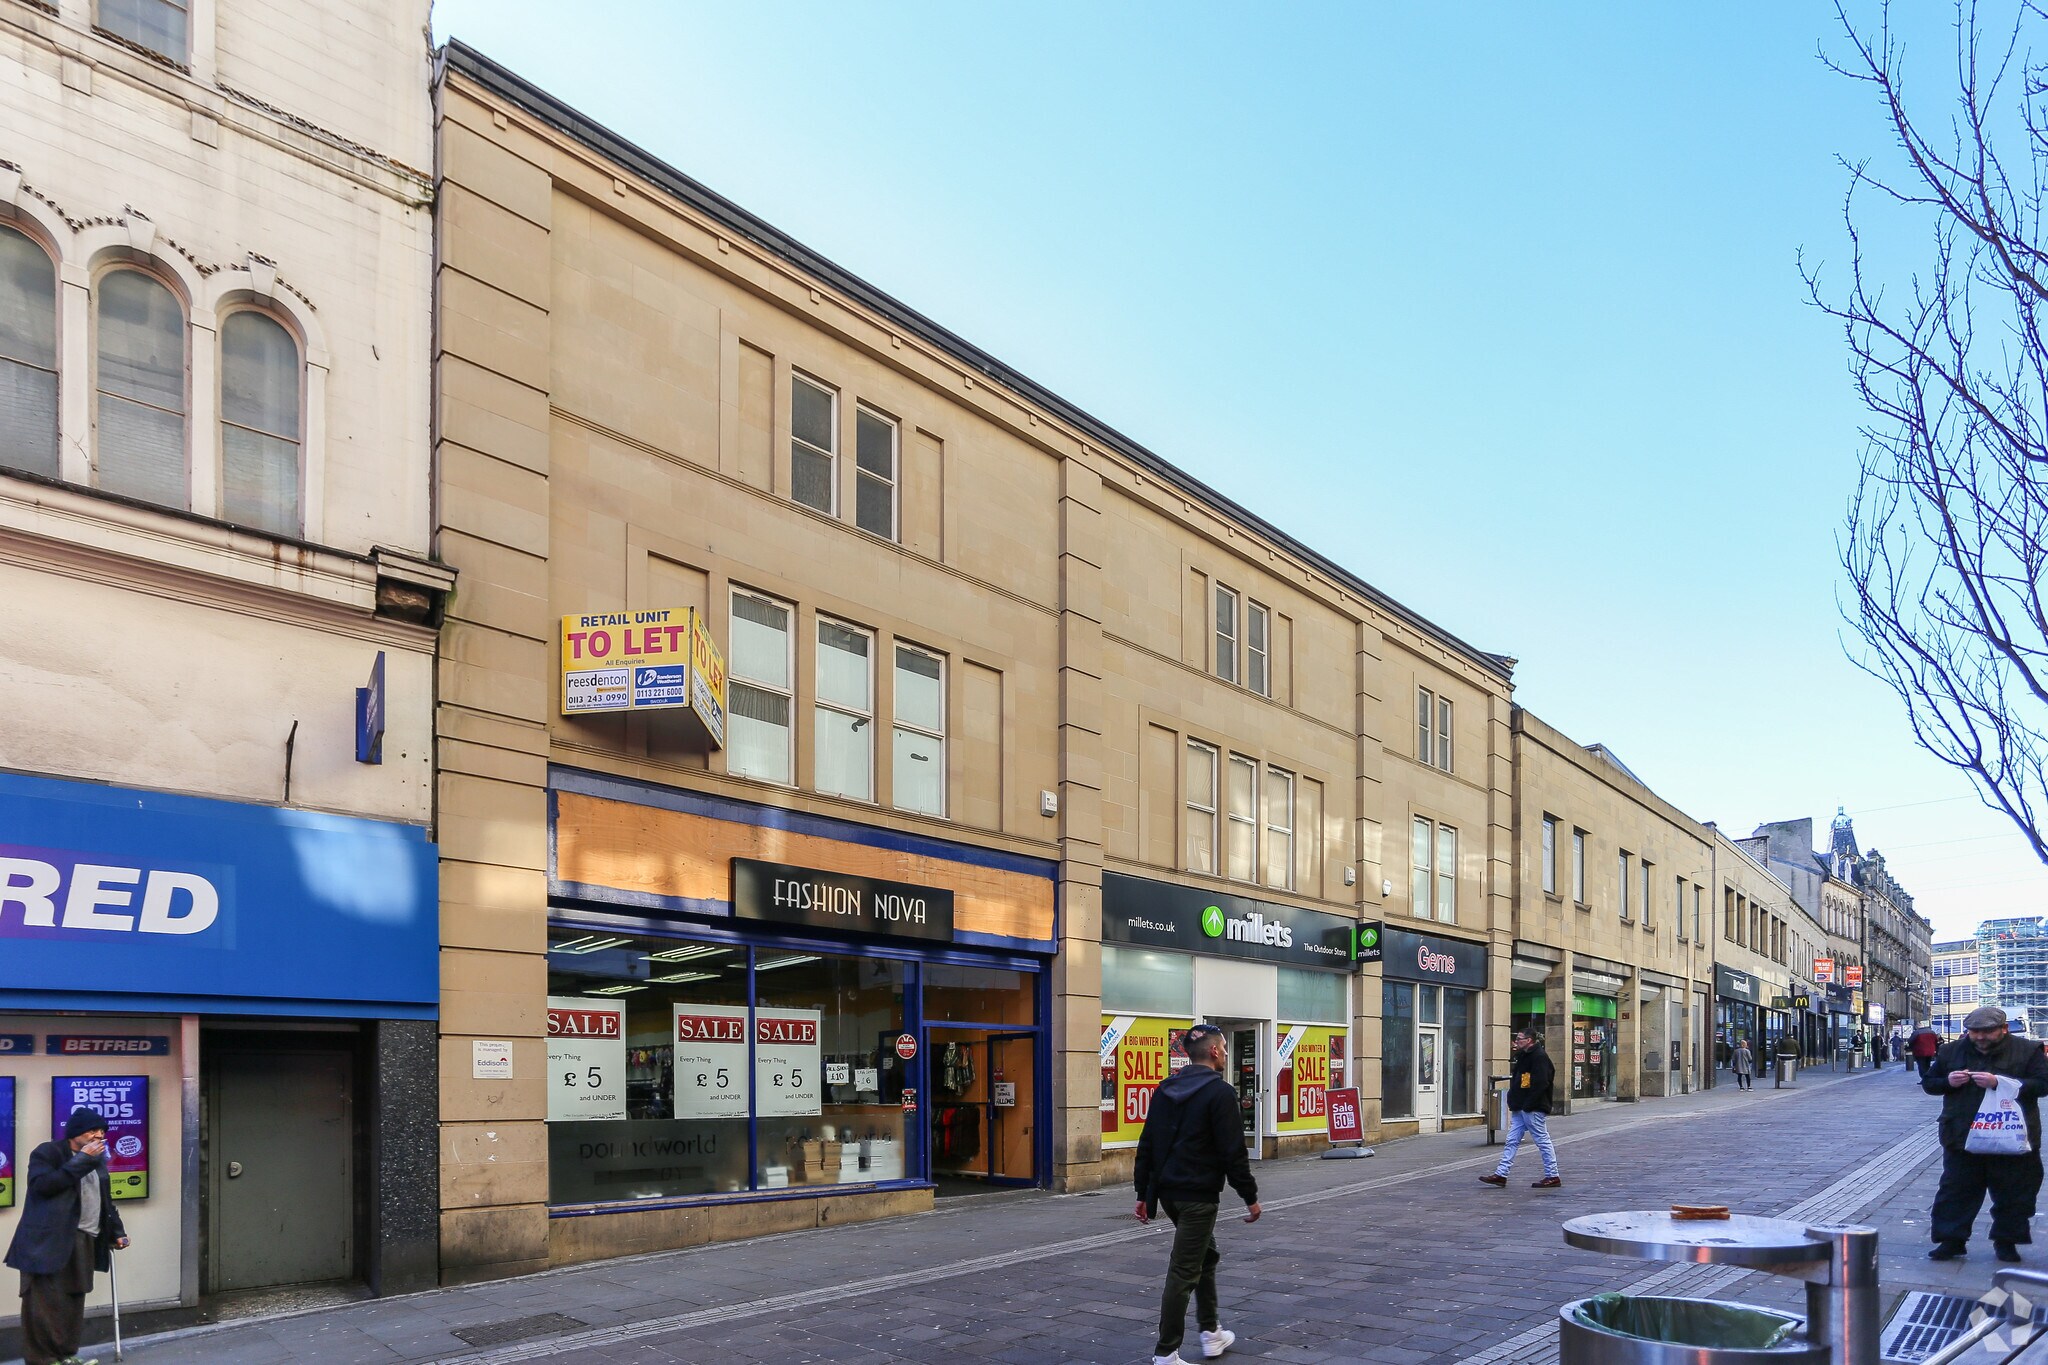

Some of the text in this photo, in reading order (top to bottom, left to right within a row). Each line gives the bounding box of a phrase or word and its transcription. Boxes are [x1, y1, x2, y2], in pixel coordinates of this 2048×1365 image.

[581, 611, 670, 627] RETAIL UNIT
[568, 625, 684, 658] TO LET
[615, 658, 645, 667] Enquiries
[694, 628, 723, 695] TO LET
[568, 673, 627, 688] reesdenton
[568, 693, 627, 704] 0113 243 0990
[637, 687, 682, 697] 0113 221 6000
[773, 878, 926, 924] FASHION NOVA
[1128, 917, 1175, 933] millets.co.uk
[1226, 912, 1293, 948] millets
[1303, 942, 1347, 957] The Outdoor Store
[1357, 948, 1380, 958] millets
[1417, 945, 1456, 974] Gems
[548, 1013, 617, 1036] SALE
[681, 1019, 742, 1040] SALE
[759, 1022, 814, 1042] SALE
[65, 1039, 152, 1051] BETFRED
[1100, 1027, 1117, 1050] INAL
[1129, 1036, 1139, 1046] BIG
[1140, 1036, 1159, 1047] WINTER
[1279, 1035, 1295, 1057] FINAL
[1309, 1044, 1322, 1053] WINTER
[548, 1053, 581, 1062] very Thing
[679, 1056, 711, 1064] Every Thing
[757, 1057, 787, 1065] Every Thing
[1124, 1050, 1163, 1080] SALE
[1298, 1056, 1325, 1081] SALE
[73, 1087, 131, 1103] BEST
[1300, 1086, 1323, 1115] 50%
[1332, 1101, 1354, 1113] Sale
[1974, 1110, 2020, 1122] PORTS
[1970, 1121, 2024, 1131] IRECT.COM
